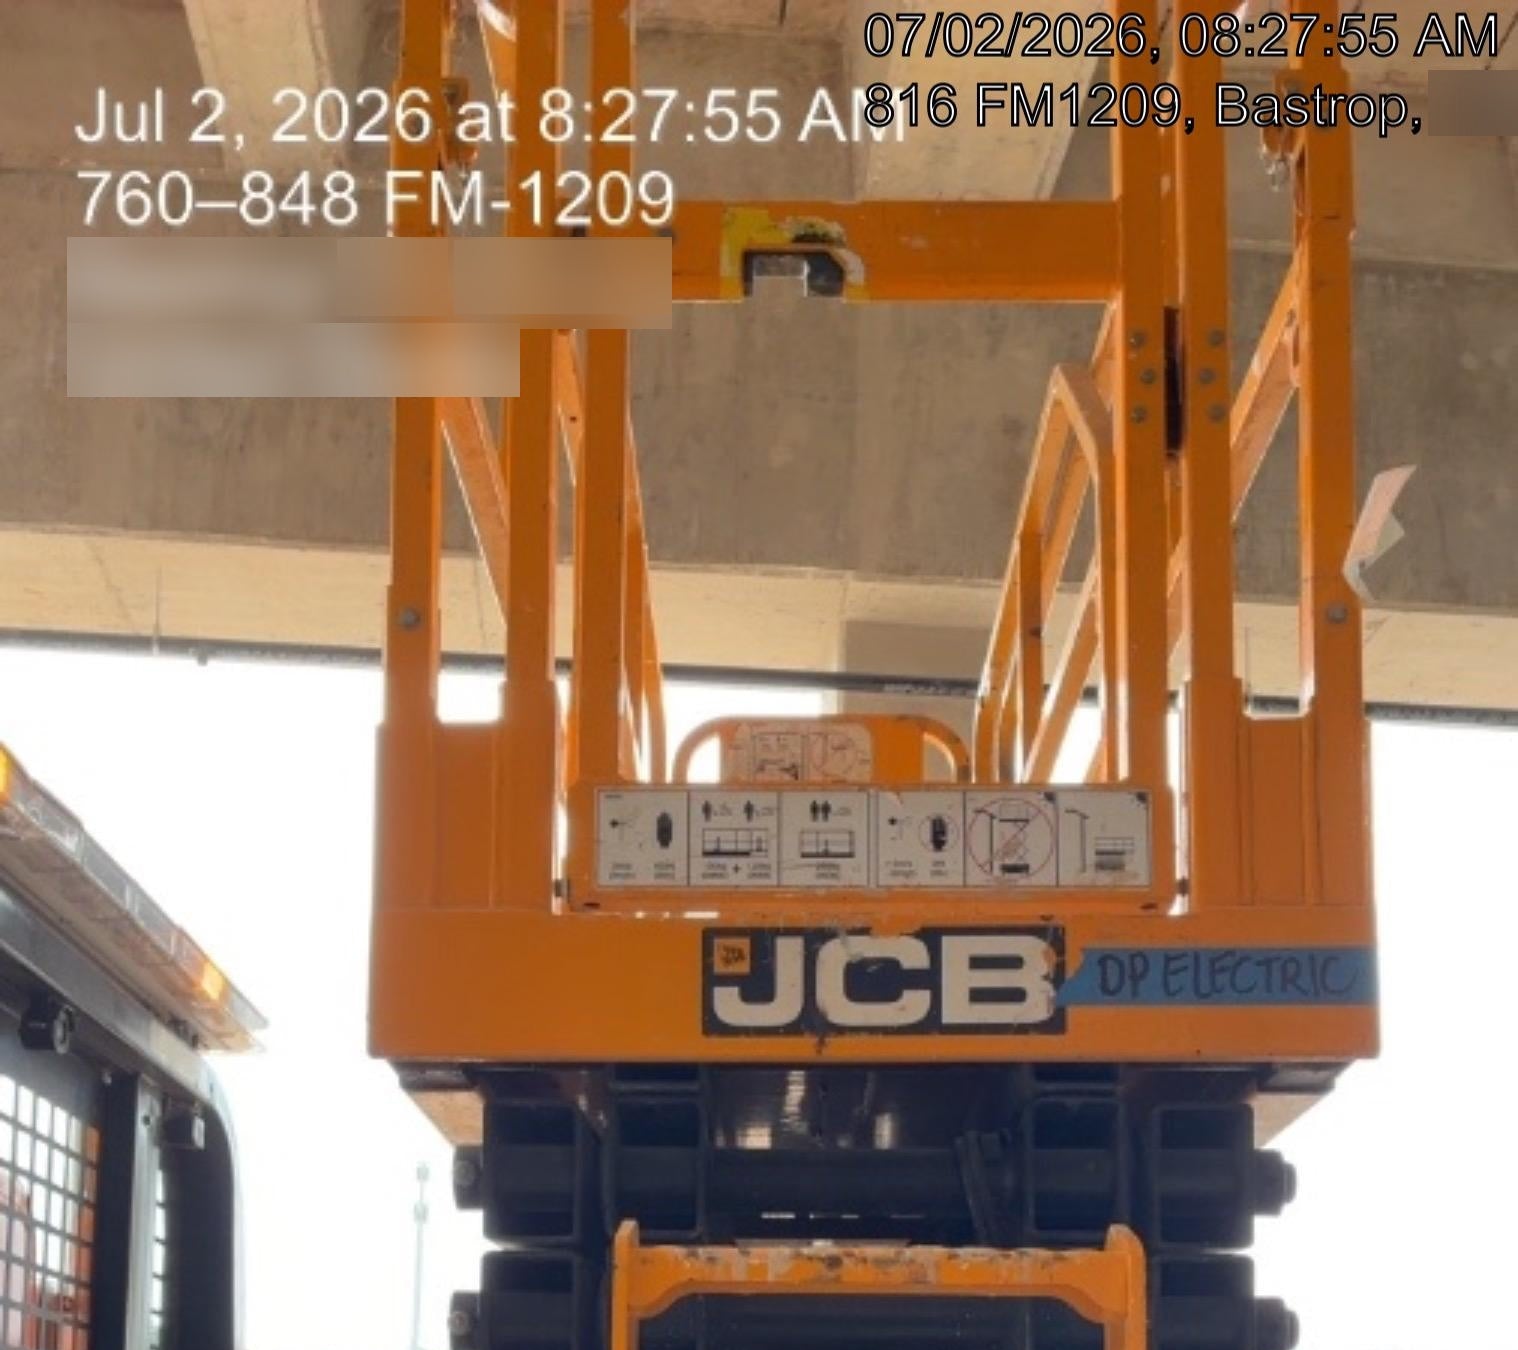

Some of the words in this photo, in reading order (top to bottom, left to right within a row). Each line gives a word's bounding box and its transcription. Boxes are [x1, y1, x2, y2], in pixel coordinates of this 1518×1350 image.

[712, 935, 1057, 1027] JCB
[1098, 951, 1149, 998] DP
[1161, 950, 1360, 999] ELECTRIC
